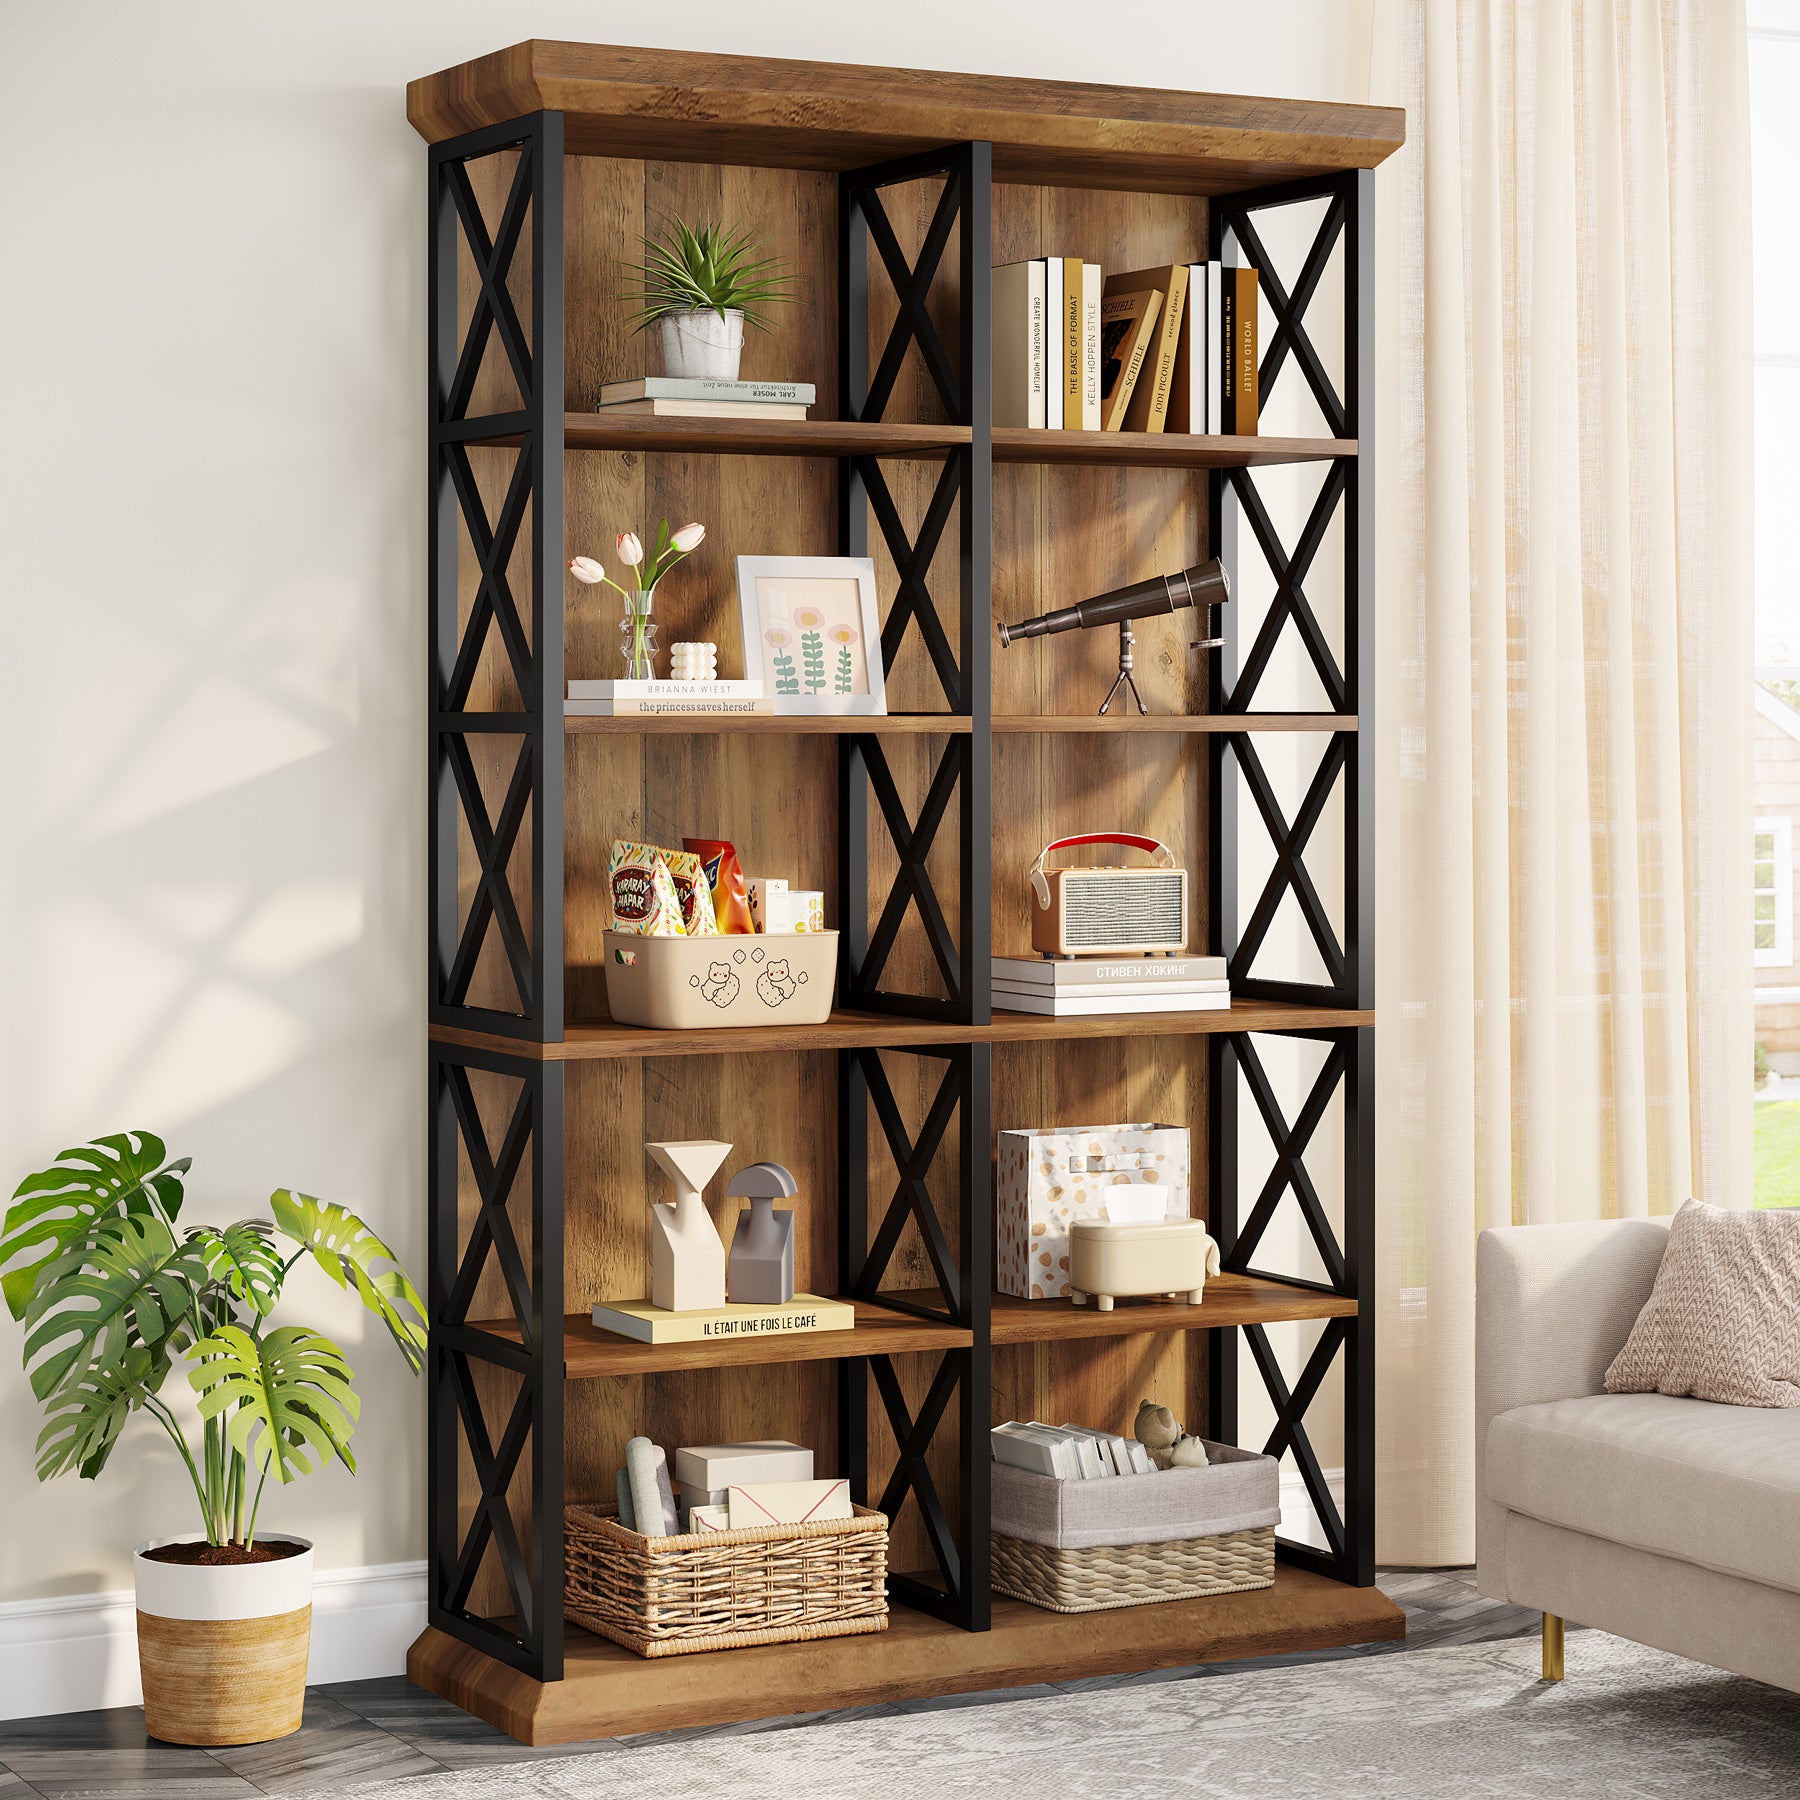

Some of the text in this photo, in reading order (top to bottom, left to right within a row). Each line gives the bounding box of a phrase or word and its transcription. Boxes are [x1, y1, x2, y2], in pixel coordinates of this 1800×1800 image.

[1033, 297, 1041, 393] CREATE WONDERFUL HOMELIFE
[1070, 295, 1078, 396] THE BASIC OF FORMAT
[1087, 302, 1096, 406] KELLY HOPPEN STYLE
[1125, 344, 1145, 387] SCHIELE
[1155, 290, 1180, 414] JODI PICOULT second glance
[1243, 320, 1252, 393] WORLD BALLET
[647, 685, 732, 694] BRIANNA WIEST
[1096, 964, 1189, 978] СТИВЕН ХОКИНГ
[704, 1312, 817, 1335] IL ÉTAIT UNE FOIS LE CAFÉ
